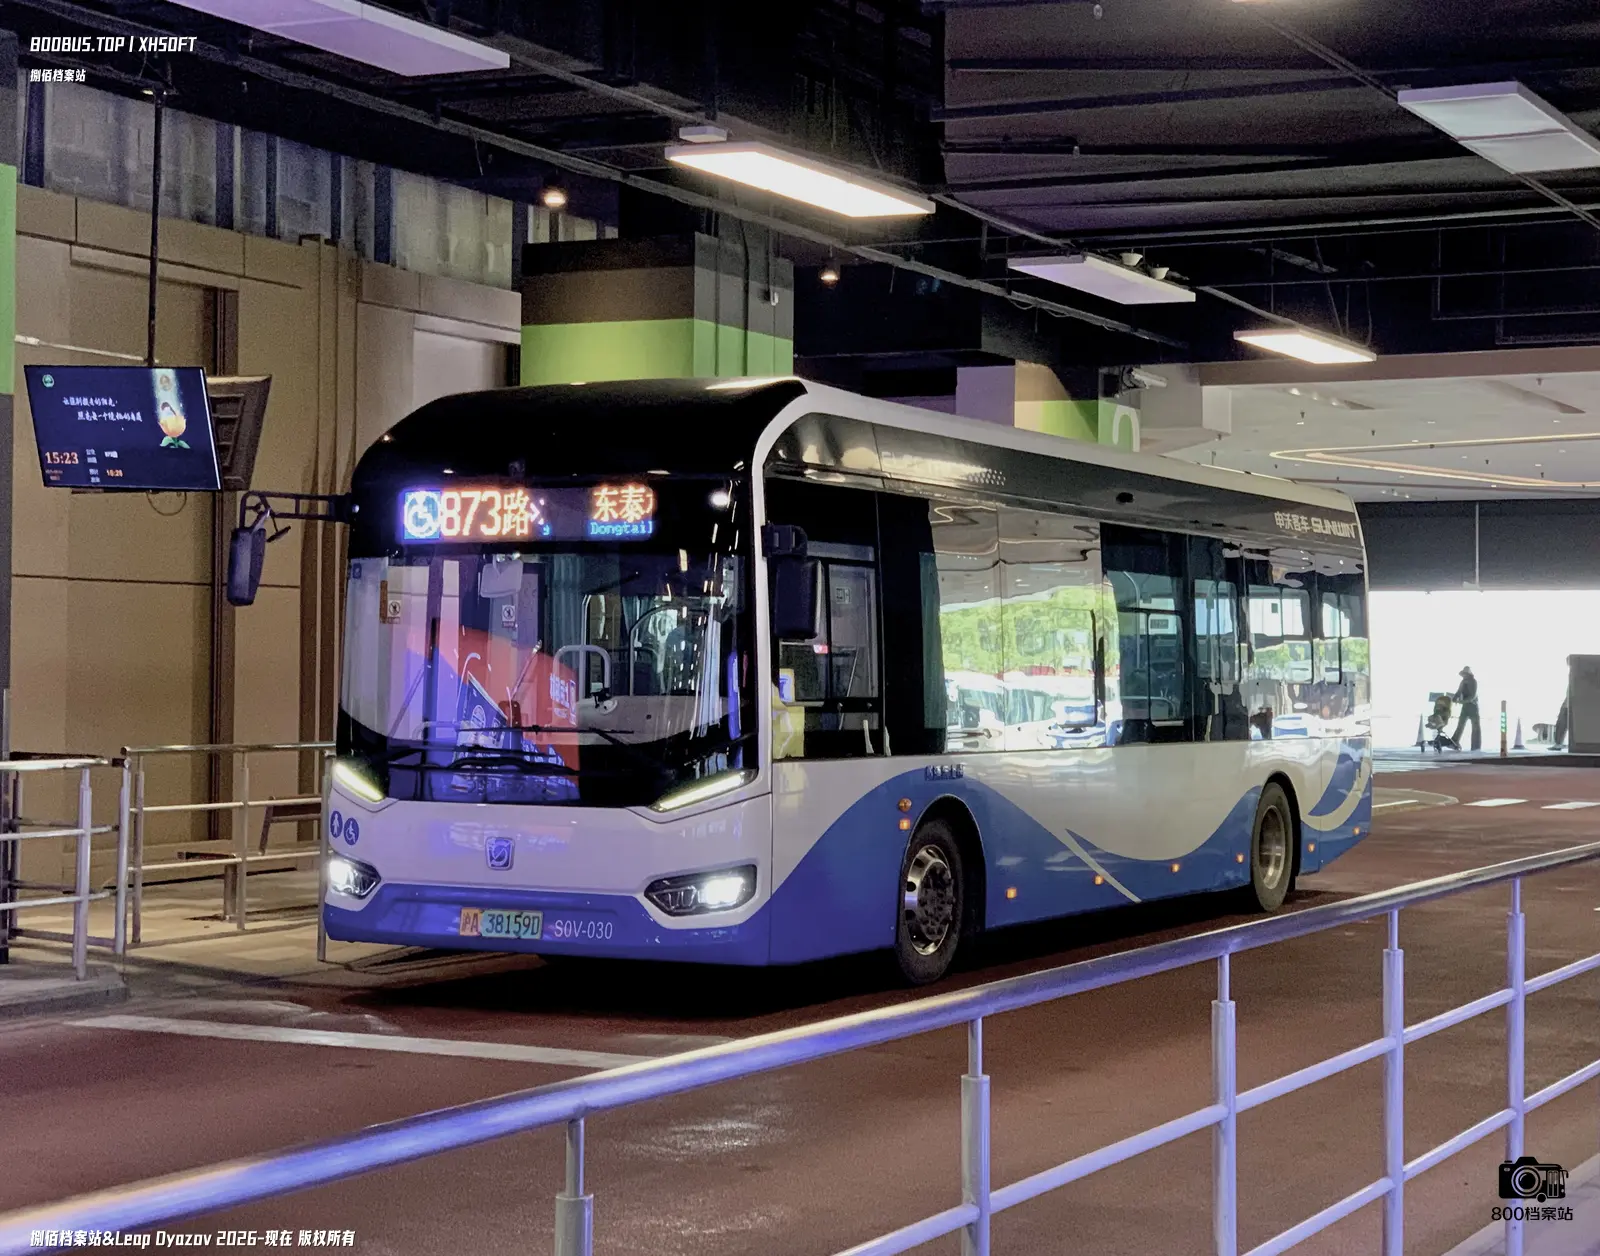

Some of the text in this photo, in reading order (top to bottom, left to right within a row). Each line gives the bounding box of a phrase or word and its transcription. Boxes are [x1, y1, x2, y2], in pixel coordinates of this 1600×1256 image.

[45, 451, 79, 465] 15:23
[440, 490, 530, 537] 873路
[1274, 511, 1357, 539] 申沃客车 SUNWIN
